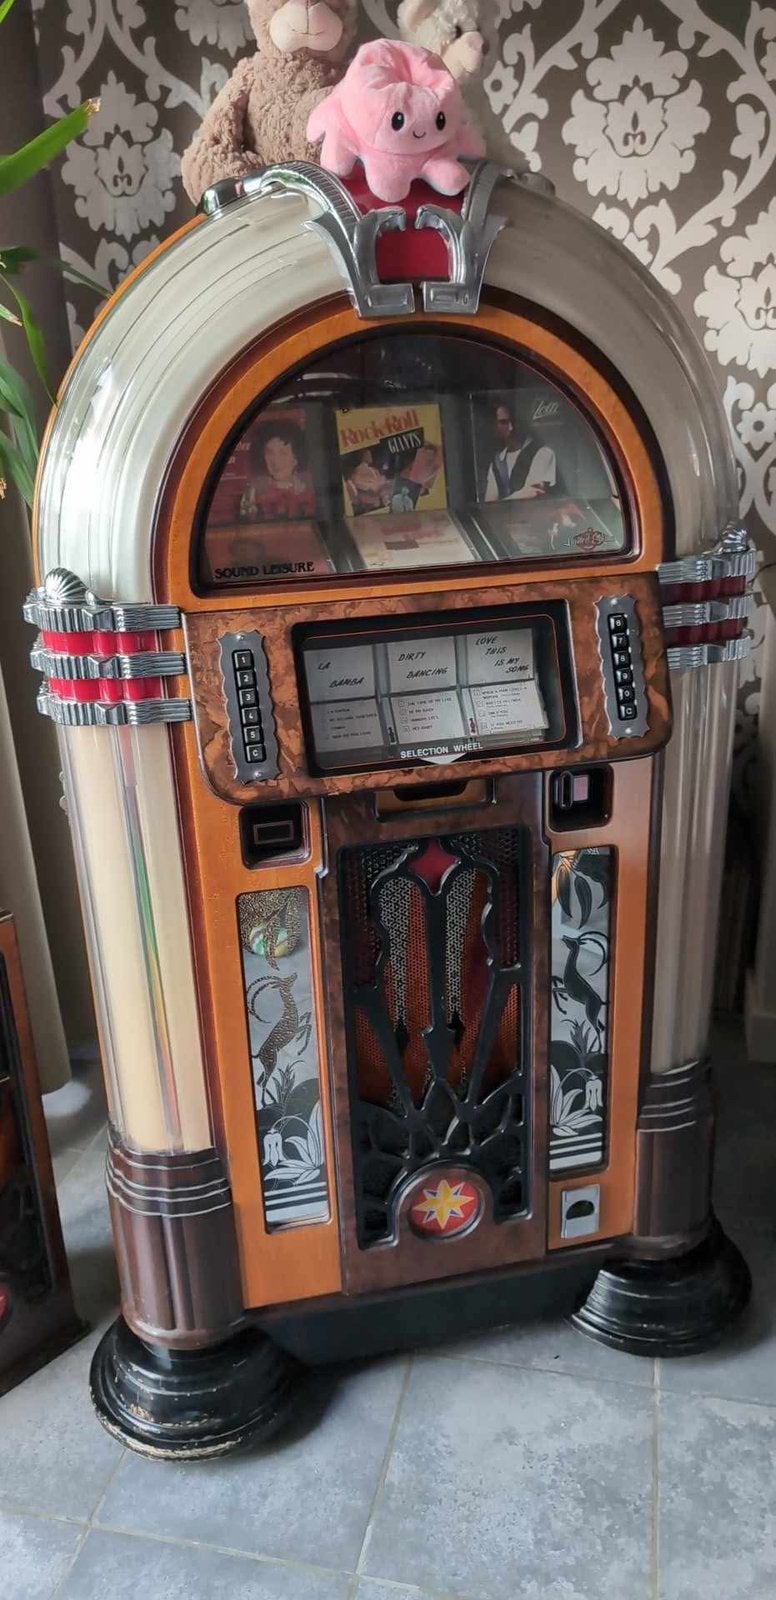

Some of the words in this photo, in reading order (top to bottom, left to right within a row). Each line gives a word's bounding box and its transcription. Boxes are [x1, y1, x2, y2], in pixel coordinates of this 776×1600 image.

[387, 432, 422, 454] GIANTS
[214, 566, 259, 579] SOUND
[263, 561, 315, 575] LEISURE
[475, 636, 498, 646] LOVE
[485, 646, 507, 656] THIS
[398, 651, 426, 662] DIRTY
[318, 661, 331, 671] LA
[494, 659, 505, 667] IS
[506, 657, 520, 666] MY
[406, 666, 449, 679] DANCING
[506, 664, 529, 674] SONG
[329, 677, 365, 689] BAMBA
[252, 749, 258, 757] C
[400, 746, 449, 759] SELECTION
[453, 741, 484, 753] WHEEL
